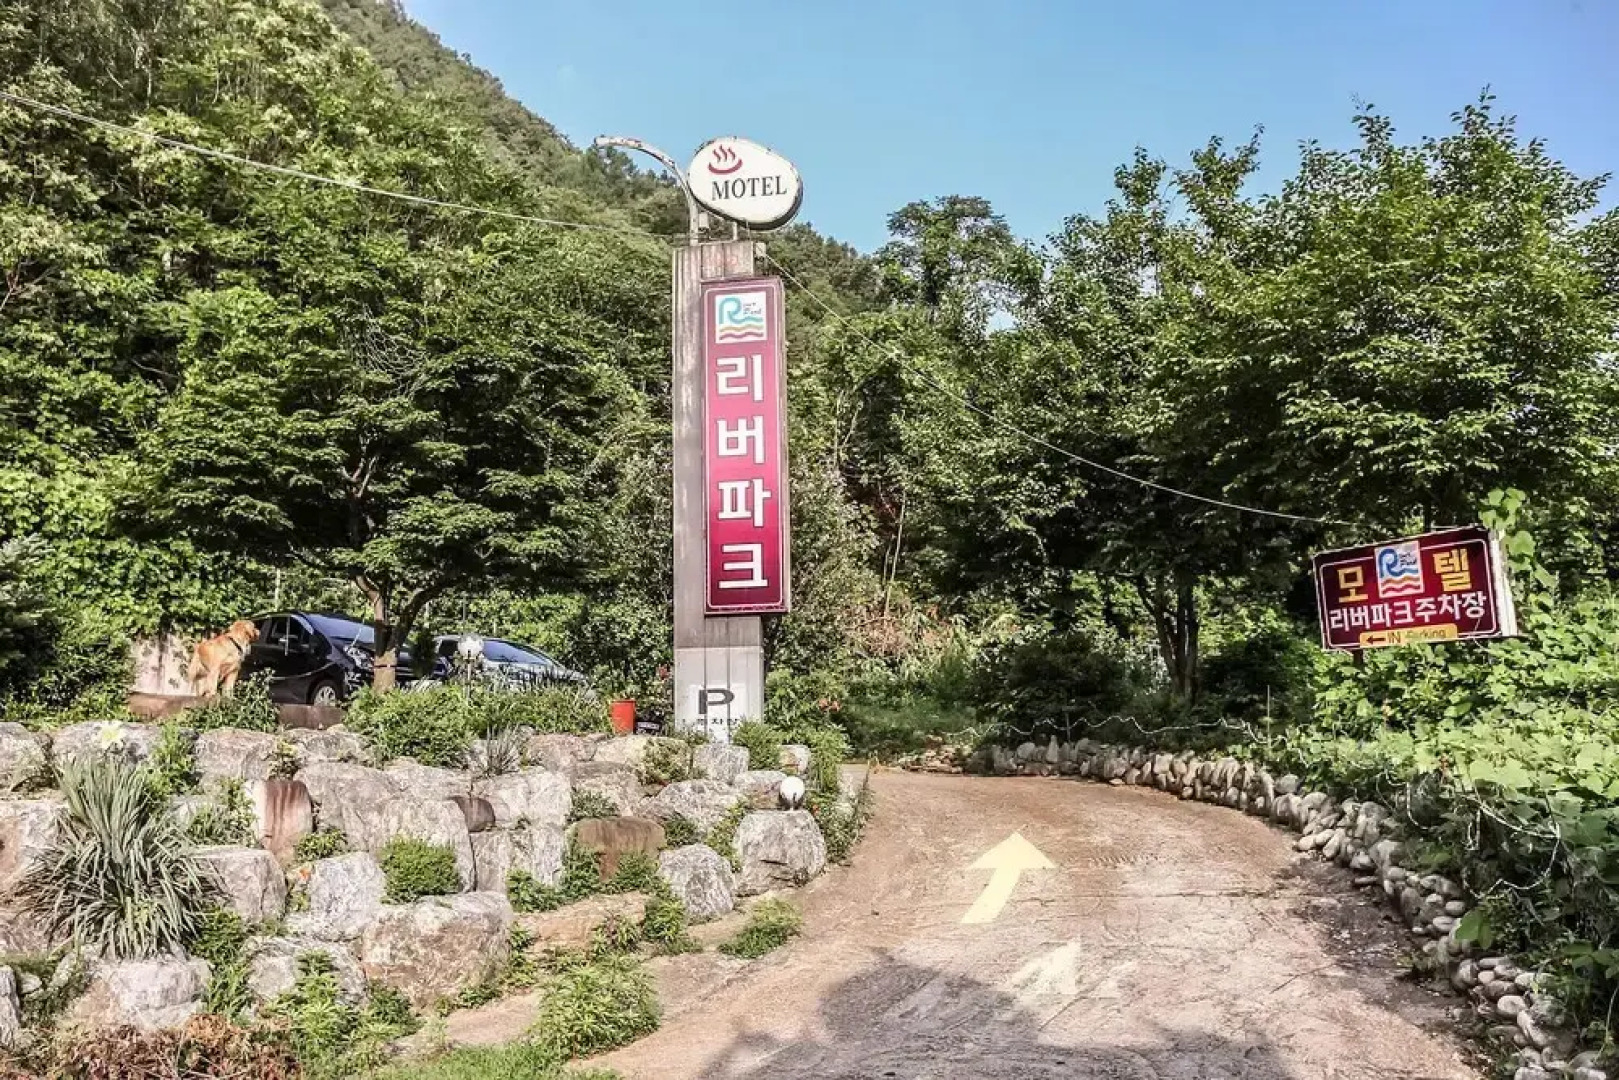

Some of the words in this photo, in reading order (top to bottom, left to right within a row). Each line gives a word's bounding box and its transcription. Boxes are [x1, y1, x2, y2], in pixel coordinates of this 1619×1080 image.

[712, 177, 787, 200] MOTEL
[716, 354, 771, 588] 리버파크
[1330, 591, 1486, 631] 리버파크주차장
[1387, 630, 1401, 644] IN
[698, 688, 735, 714] P
